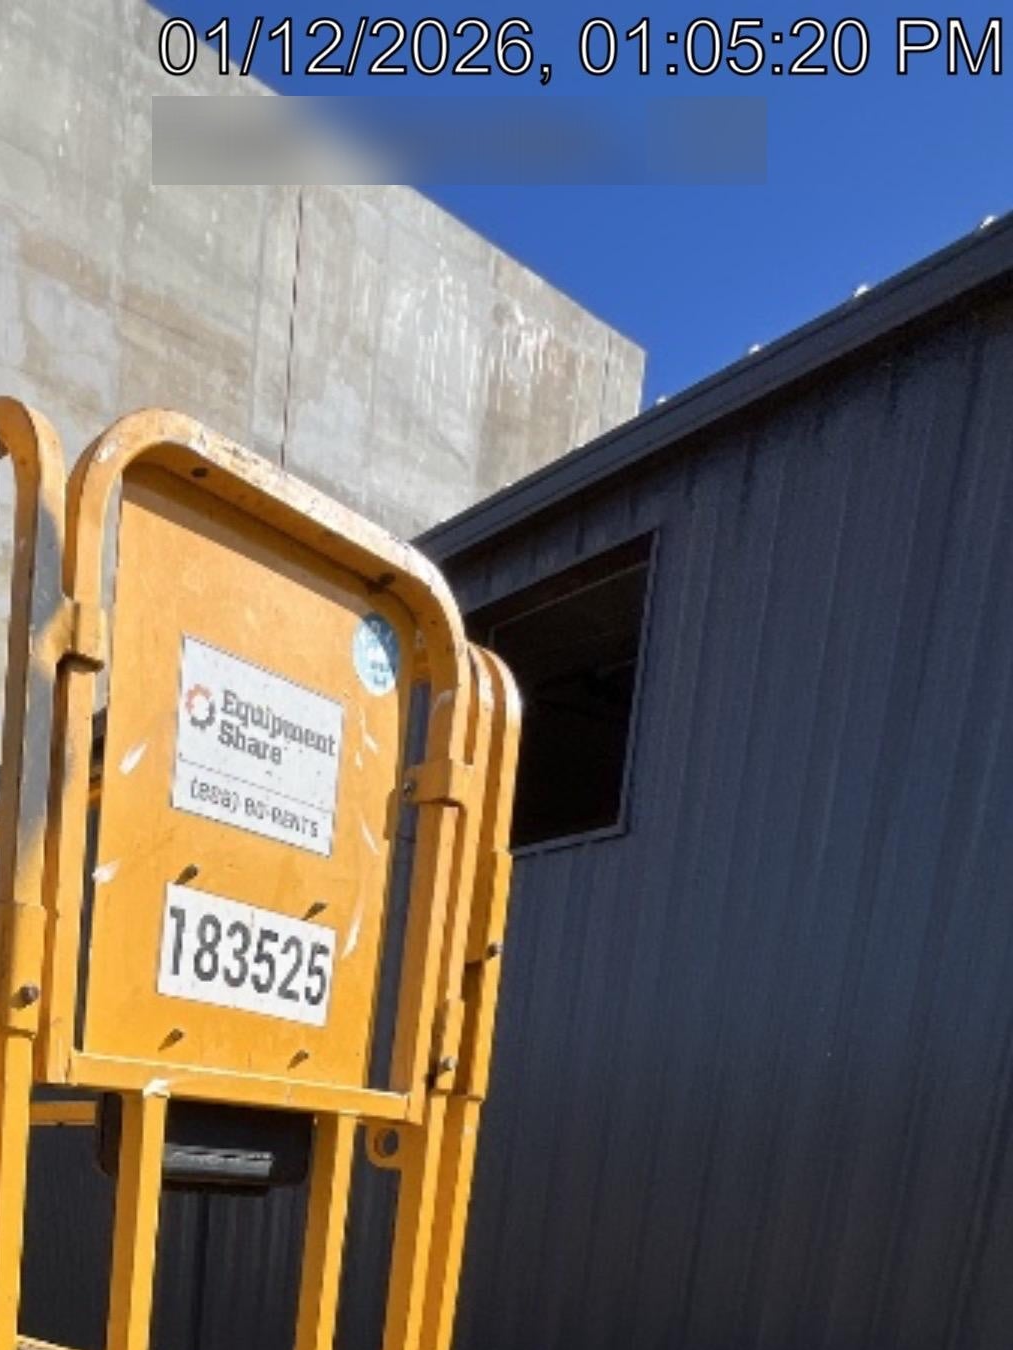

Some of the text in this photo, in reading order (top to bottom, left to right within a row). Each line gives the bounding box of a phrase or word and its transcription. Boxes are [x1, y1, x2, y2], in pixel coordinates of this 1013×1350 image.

[218, 719, 283, 765] Share
[220, 689, 336, 757] Equipment
[168, 905, 330, 1007] 183525
